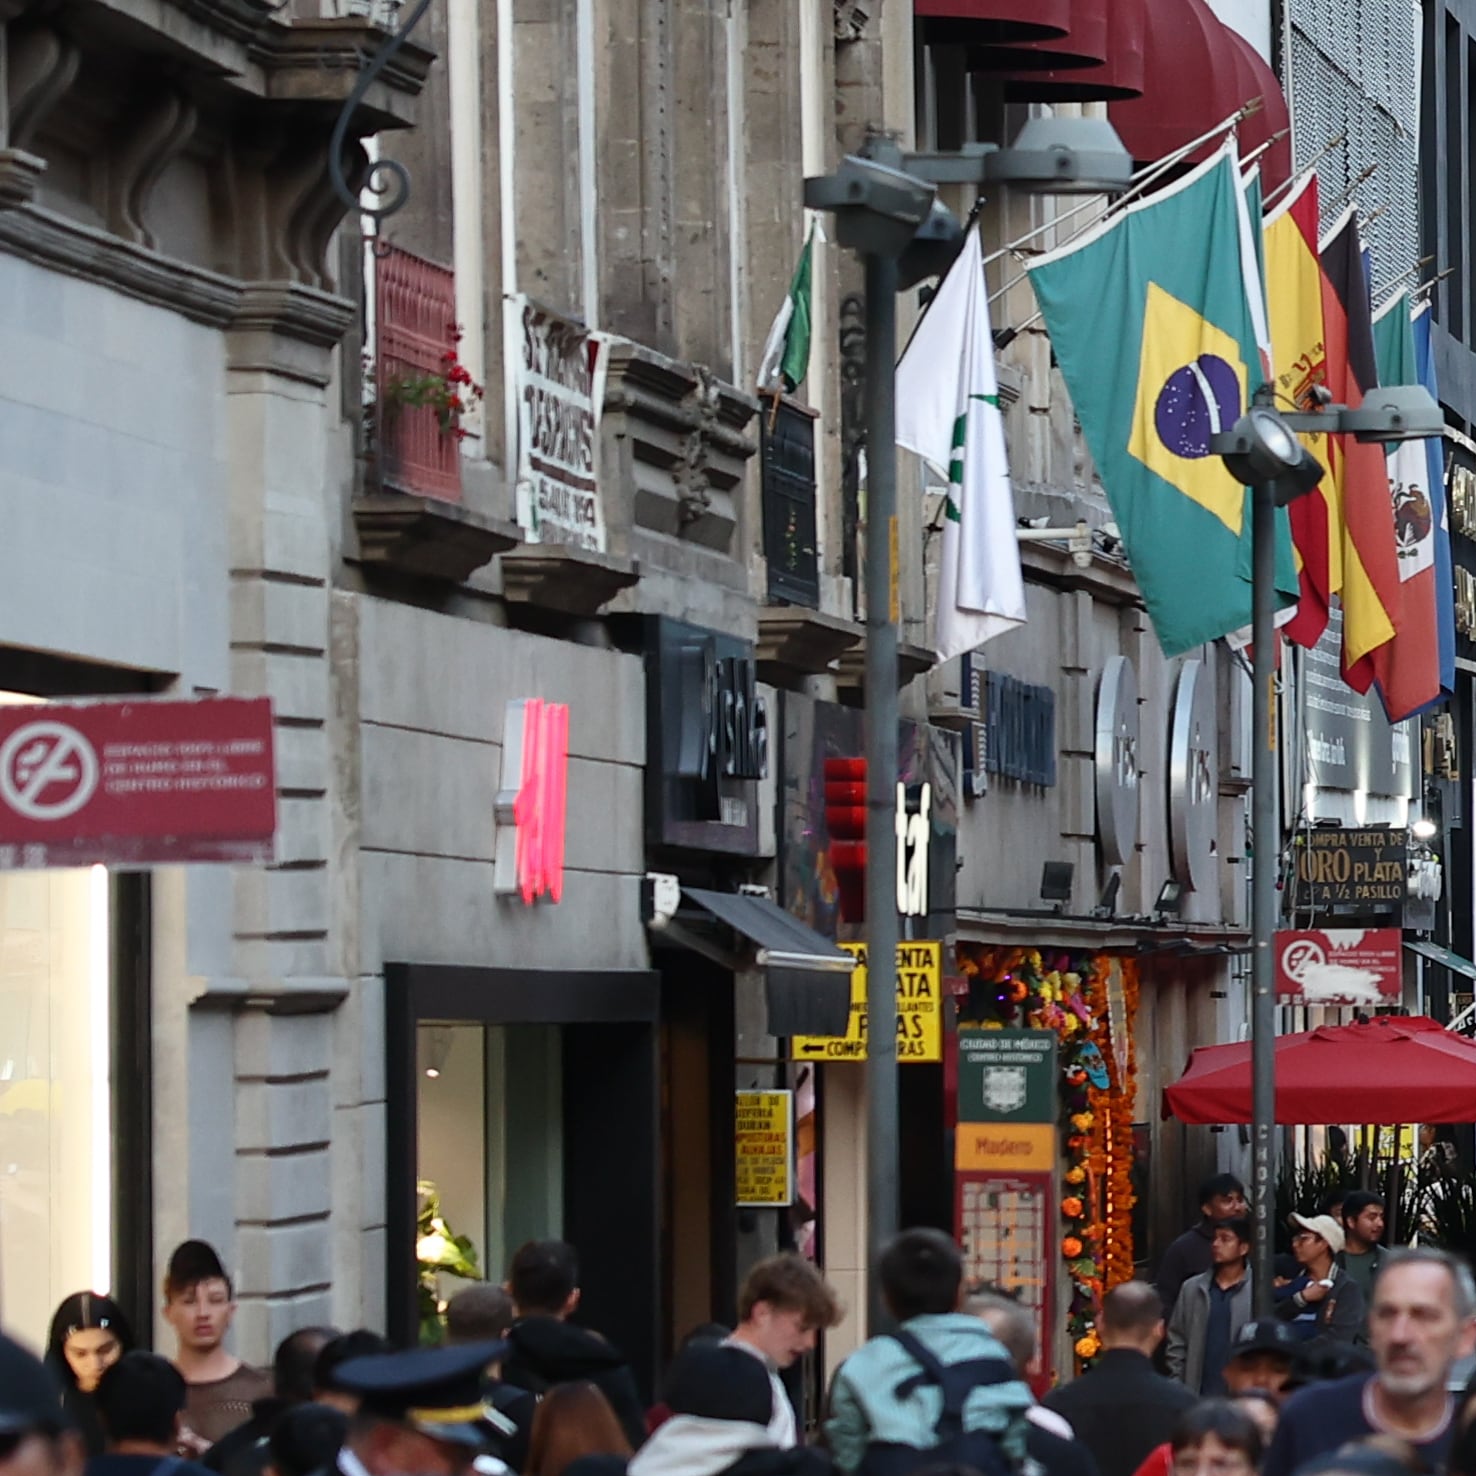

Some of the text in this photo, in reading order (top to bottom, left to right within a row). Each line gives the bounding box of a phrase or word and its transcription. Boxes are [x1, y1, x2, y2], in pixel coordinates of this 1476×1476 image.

[1350, 832, 1385, 846] VENTA
[1390, 832, 1403, 846] DE
[1374, 847, 1382, 860] Y
[1300, 848, 1351, 883] ORO
[1354, 862, 1402, 882] PLATA
[1356, 885, 1401, 899] PASILLO
[896, 948, 934, 968] ENTA
[896, 973, 932, 998] ATA
[826, 1041, 925, 1057] COMPRAS
